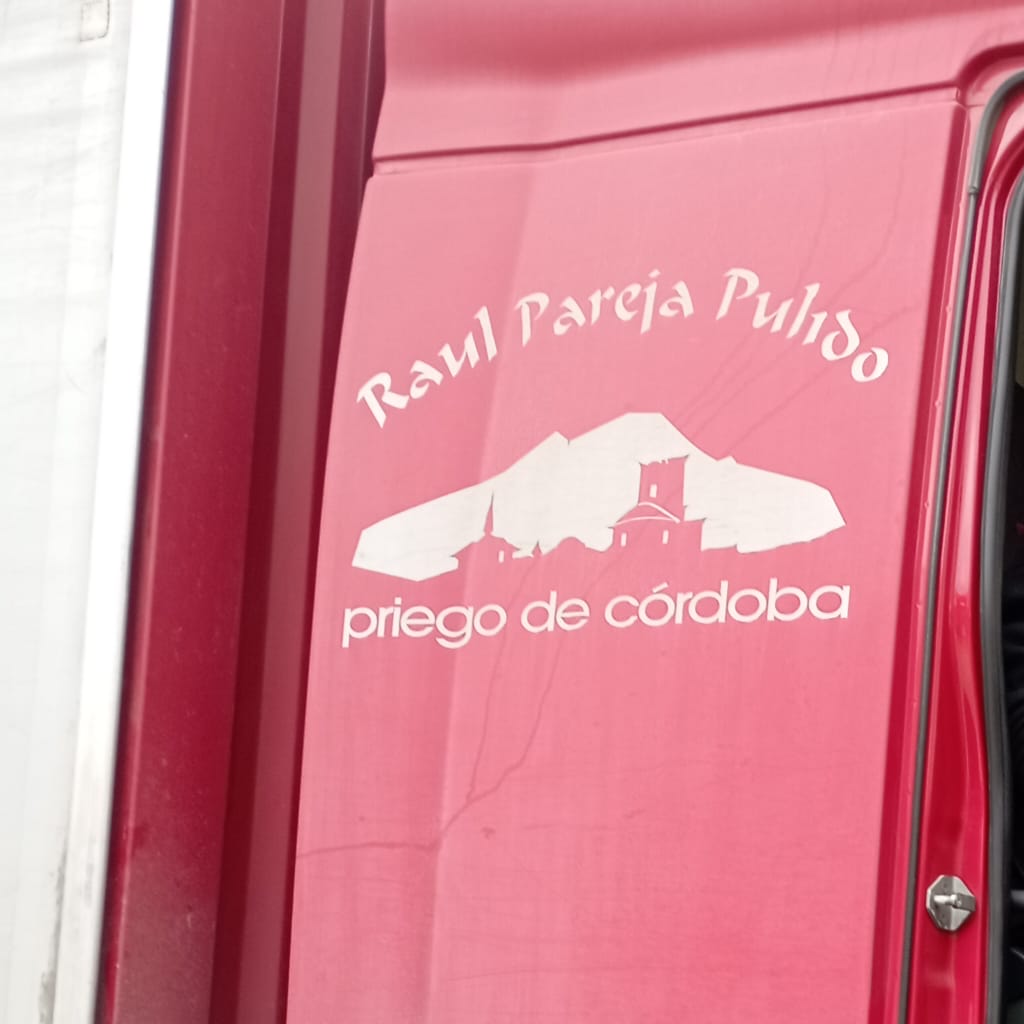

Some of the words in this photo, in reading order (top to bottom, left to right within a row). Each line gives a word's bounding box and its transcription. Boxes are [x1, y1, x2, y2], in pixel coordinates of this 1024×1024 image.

[356, 305, 498, 429] Raul
[514, 269, 695, 348] Pareja
[342, 597, 507, 650] priego
[520, 590, 591, 634] de
[604, 578, 851, 628] córdoba
